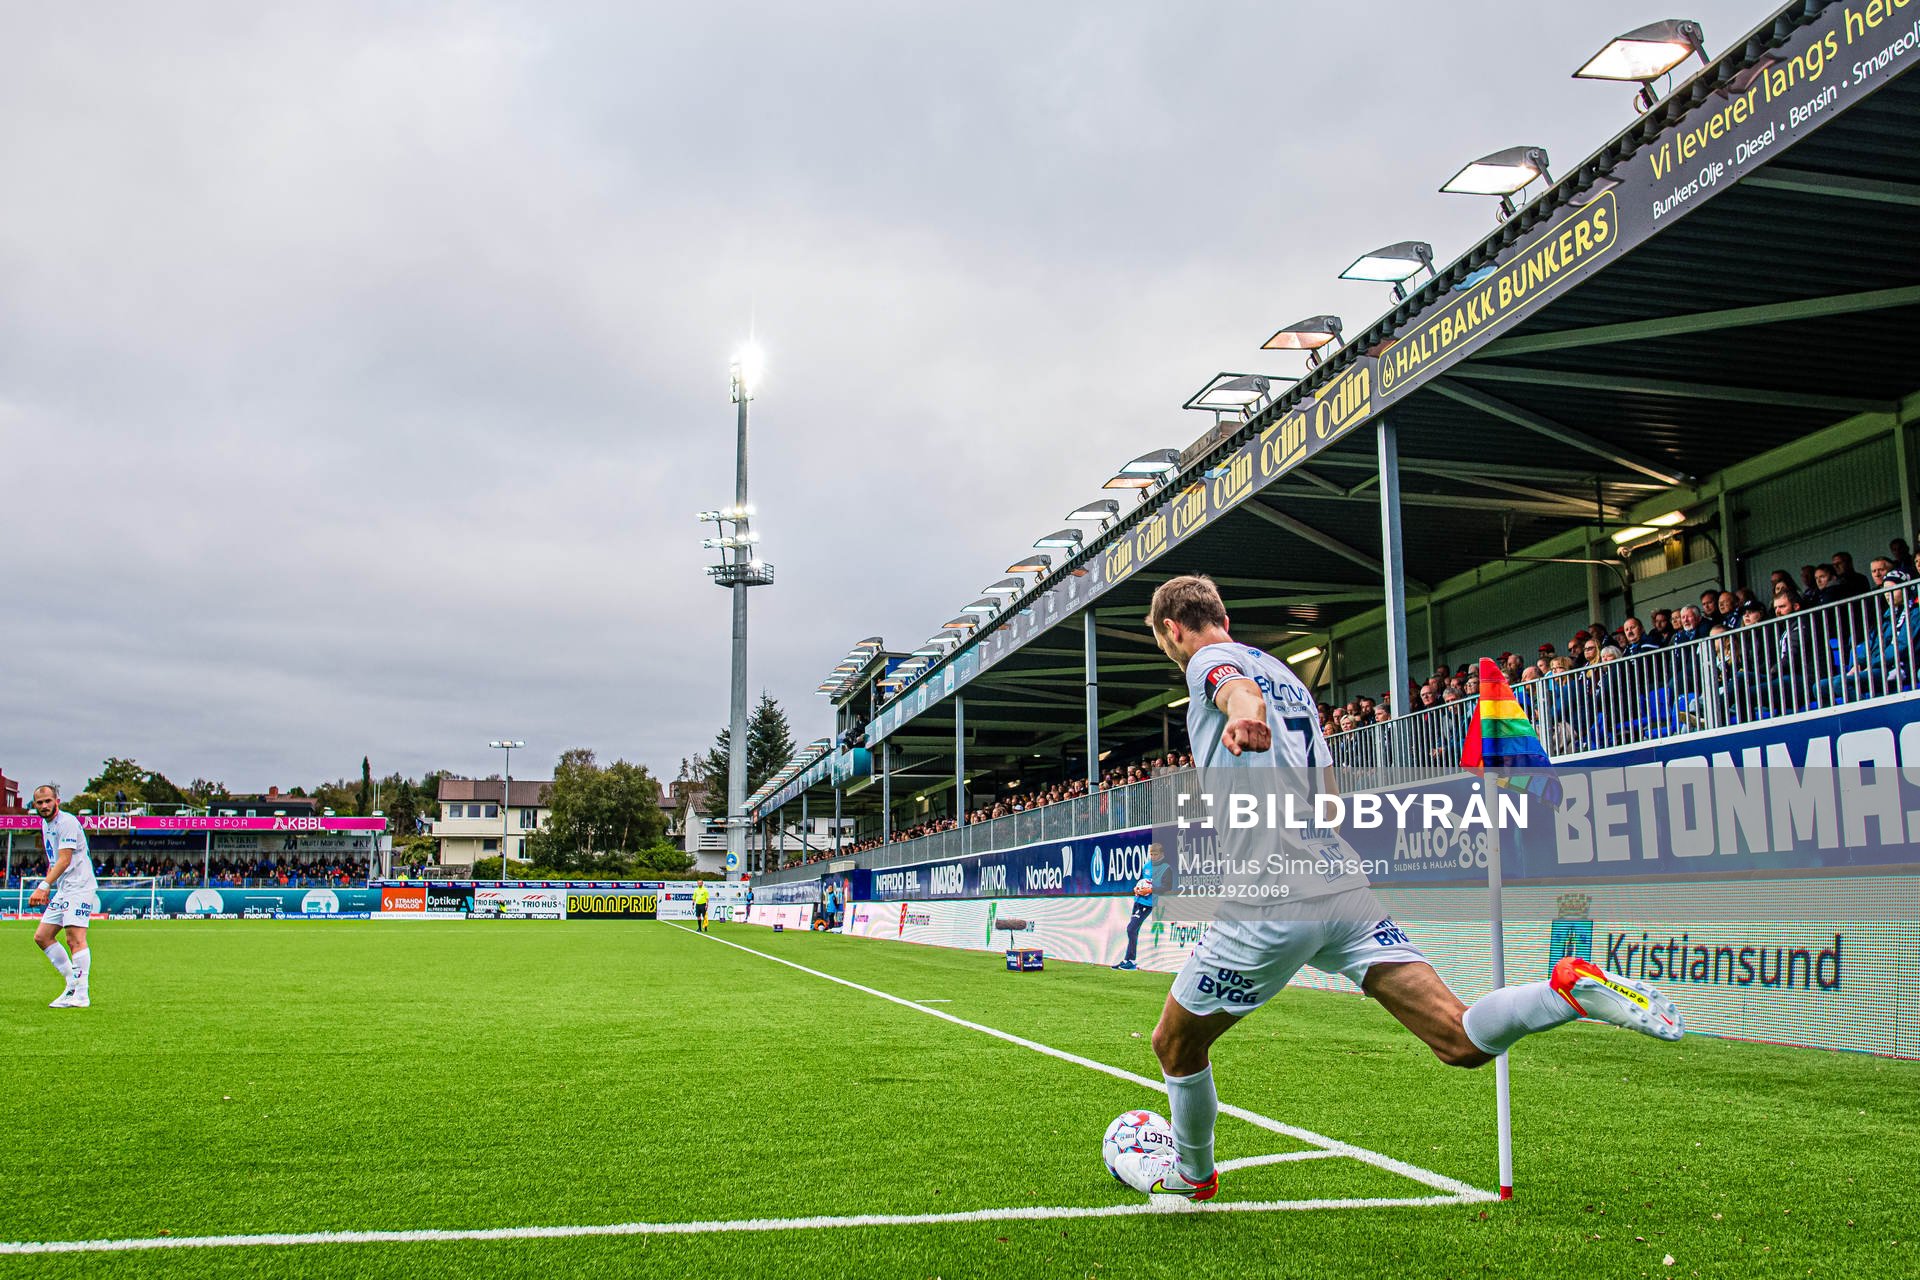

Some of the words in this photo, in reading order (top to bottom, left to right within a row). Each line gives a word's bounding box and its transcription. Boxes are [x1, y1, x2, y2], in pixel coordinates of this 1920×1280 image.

[1650, 143, 1671, 180] Vi
[1676, 87, 1757, 164] leverer
[1763, 31, 1838, 103] langs
[1653, 179, 1698, 220] Bunkers
[1699, 162, 1724, 186] Olje
[1736, 121, 1775, 164] Diesel
[1789, 85, 1837, 129] Bensin
[1396, 286, 1496, 378] HALTBAKK
[1498, 207, 1609, 310] BUNKERS
[1315, 367, 1370, 439] Odin
[1260, 412, 1307, 477] Odin
[1213, 452, 1252, 510] Odin
[1172, 484, 1207, 538] Odin
[1137, 515, 1167, 562] Odin
[1105, 540, 1132, 584] Odin
[1283, 716, 1320, 807] 7
[160, 819, 207, 827] SETTER
[214, 819, 248, 827] SPOR
[1394, 825, 1448, 861] Auto
[876, 873, 904, 891] NARDO
[905, 871, 921, 889] BIL
[930, 863, 964, 895] MAXBO
[980, 864, 1006, 892] AVINOR
[1026, 860, 1062, 890] Nordea
[1394, 863, 1420, 872] SILDNES
[1423, 862, 1428, 870] &
[1430, 860, 1457, 869] HALAAS
[427, 896, 460, 907] Optiker
[567, 894, 657, 912] BUNNPRIS
[1606, 932, 1842, 992] Kristiansund
[1197, 974, 1259, 1004] BYGG
[1143, 1131, 1174, 1148] ELECT
